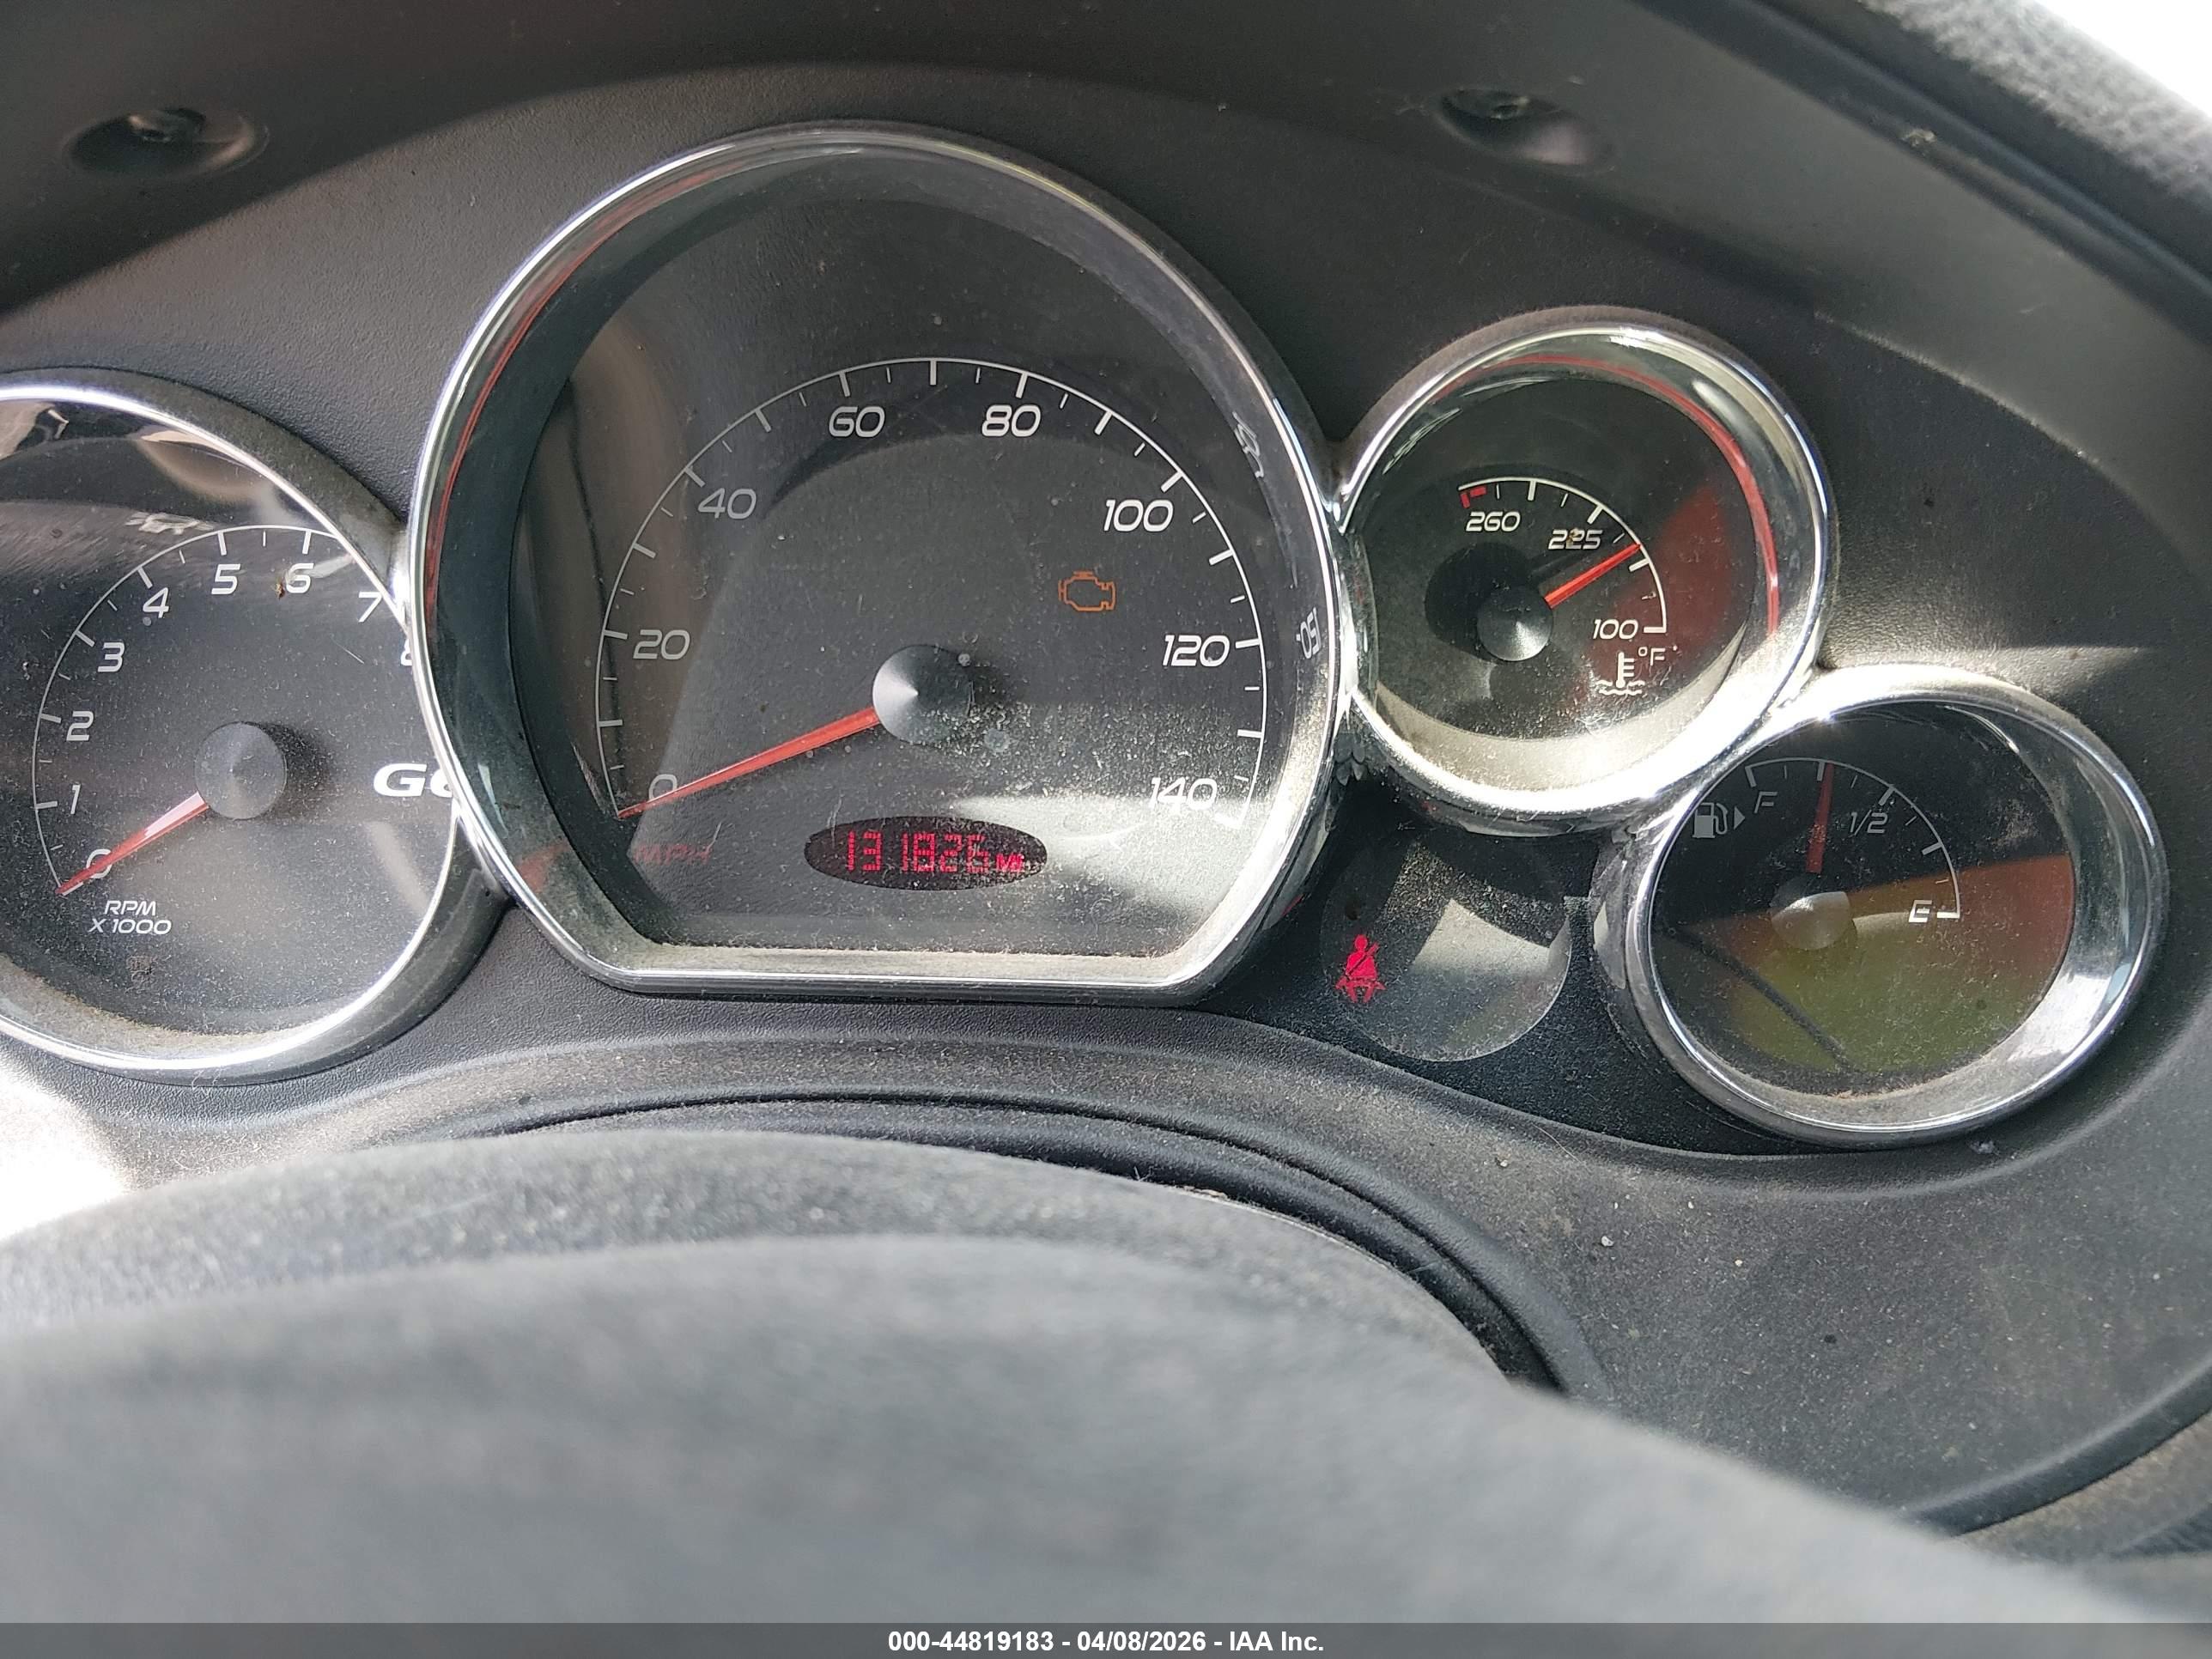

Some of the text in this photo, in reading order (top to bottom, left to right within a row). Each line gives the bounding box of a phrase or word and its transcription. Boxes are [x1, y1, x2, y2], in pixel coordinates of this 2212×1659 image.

[829, 406, 885, 437] 60
[981, 405, 1041, 436] 80
[698, 489, 757, 519] 40
[1103, 500, 1174, 532] 100
[1466, 511, 1521, 532] 260
[1547, 529, 1602, 550] 225
[211, 563, 240, 594] 5
[285, 562, 313, 593] 6
[143, 587, 169, 617] 4
[358, 591, 383, 623] 7
[633, 629, 690, 659] 20
[1593, 619, 1638, 640] 100
[98, 641, 125, 672] 3
[1163, 635, 1230, 666] 120
[66, 711, 94, 741] 2
[70, 784, 82, 815] 1
[648, 774, 678, 804] 0
[1149, 776, 1218, 809] 140
[1754, 791, 1778, 814] F
[1850, 811, 1887, 836] 1/2
[87, 848, 112, 879] 0
[848, 830, 988, 873] 131826
[104, 900, 157, 916] RPM
[1908, 899, 1932, 922] E
[88, 918, 172, 935] X 1000
